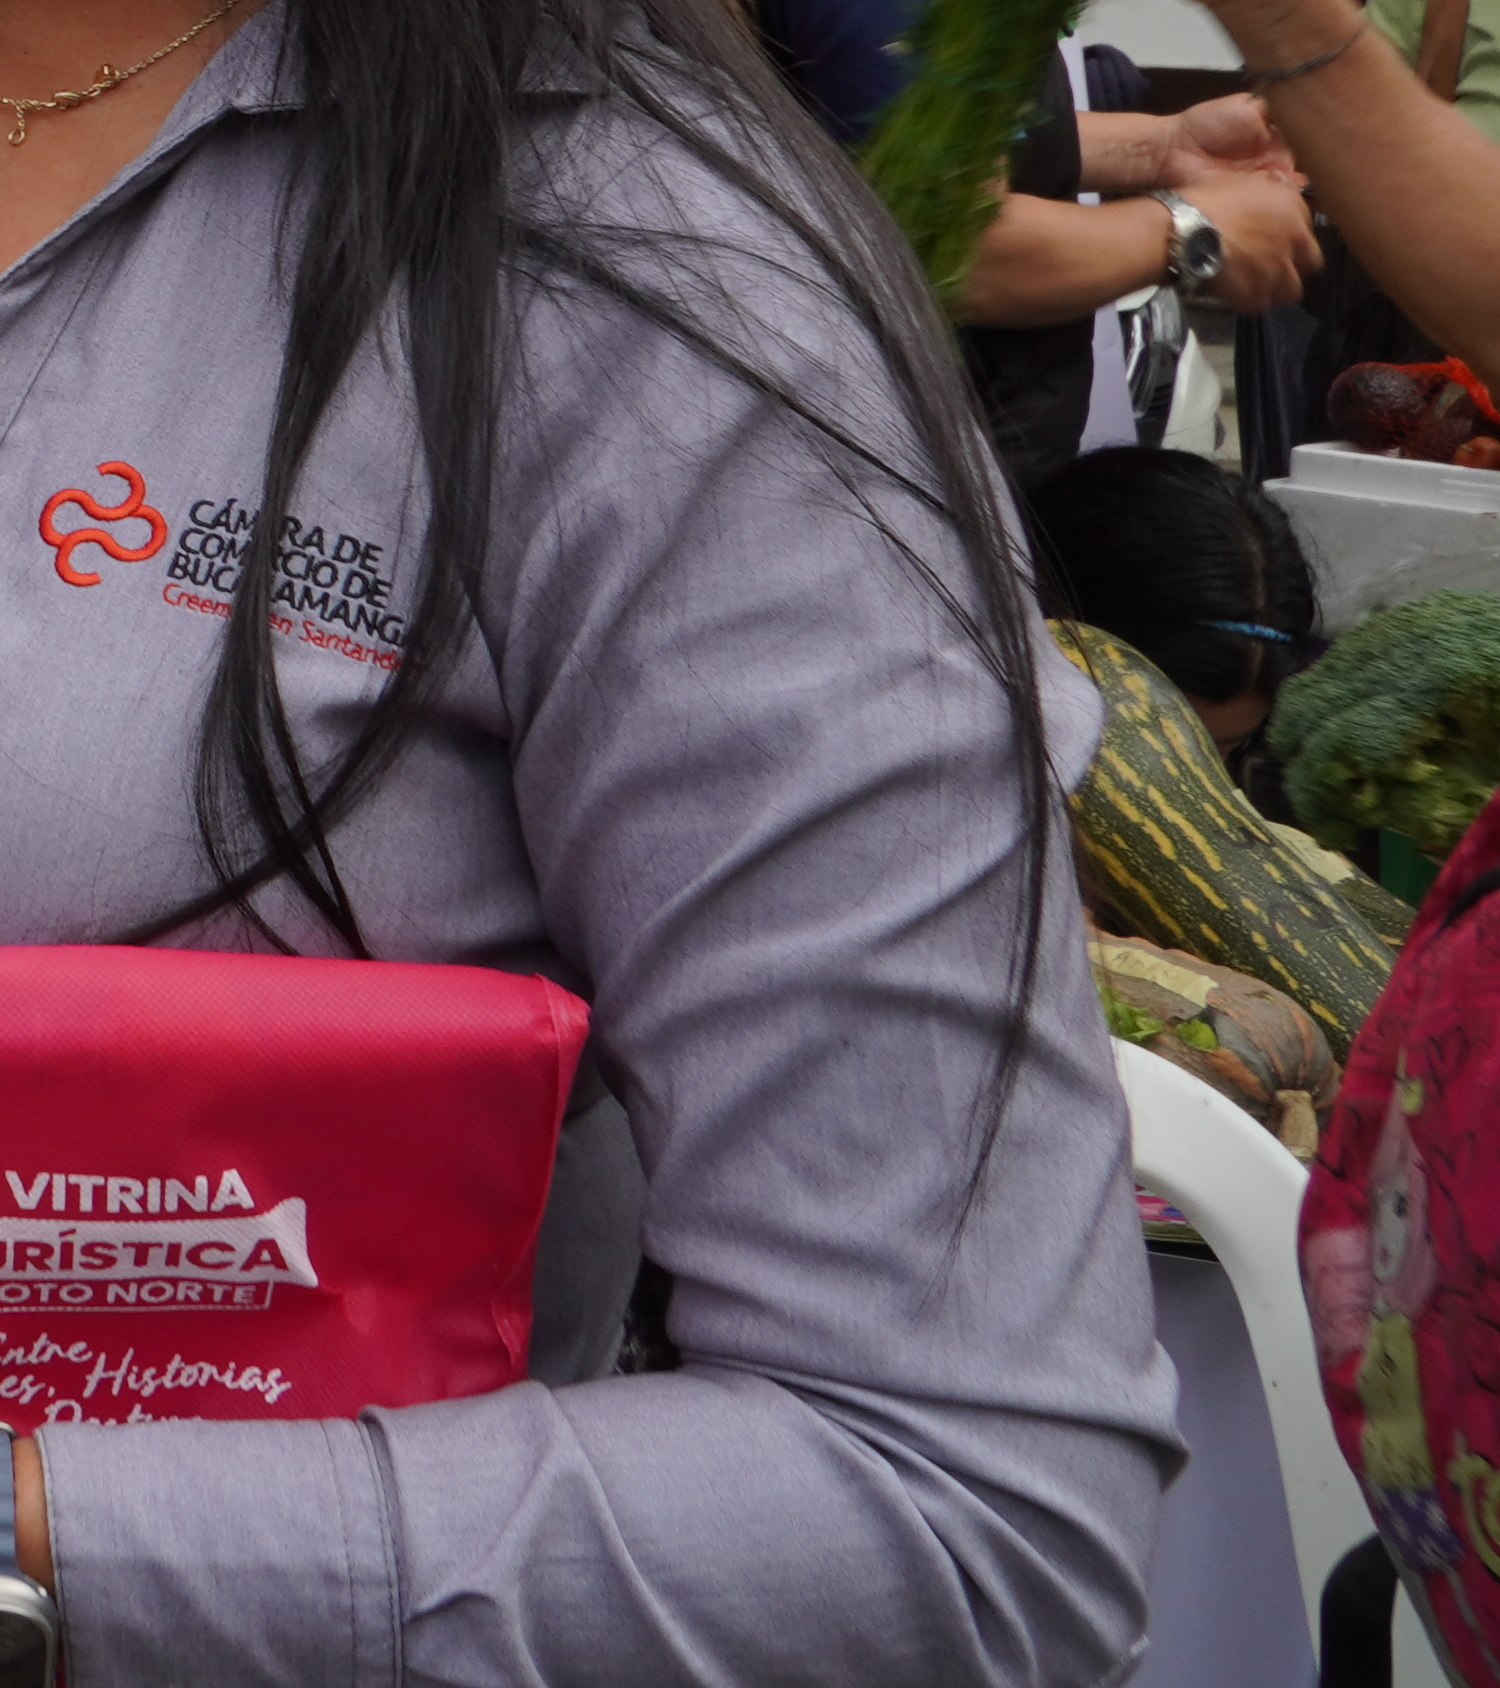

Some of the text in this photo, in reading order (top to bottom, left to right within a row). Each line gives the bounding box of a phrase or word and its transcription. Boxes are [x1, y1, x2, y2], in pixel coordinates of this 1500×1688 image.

[187, 496, 384, 576] CÁMRA DE
[177, 526, 395, 610] COMCIO DE
[4, 1167, 257, 1214] VITRINA
[105, 1278, 258, 1305] NORTE
[82, 1347, 294, 1403] Historias
